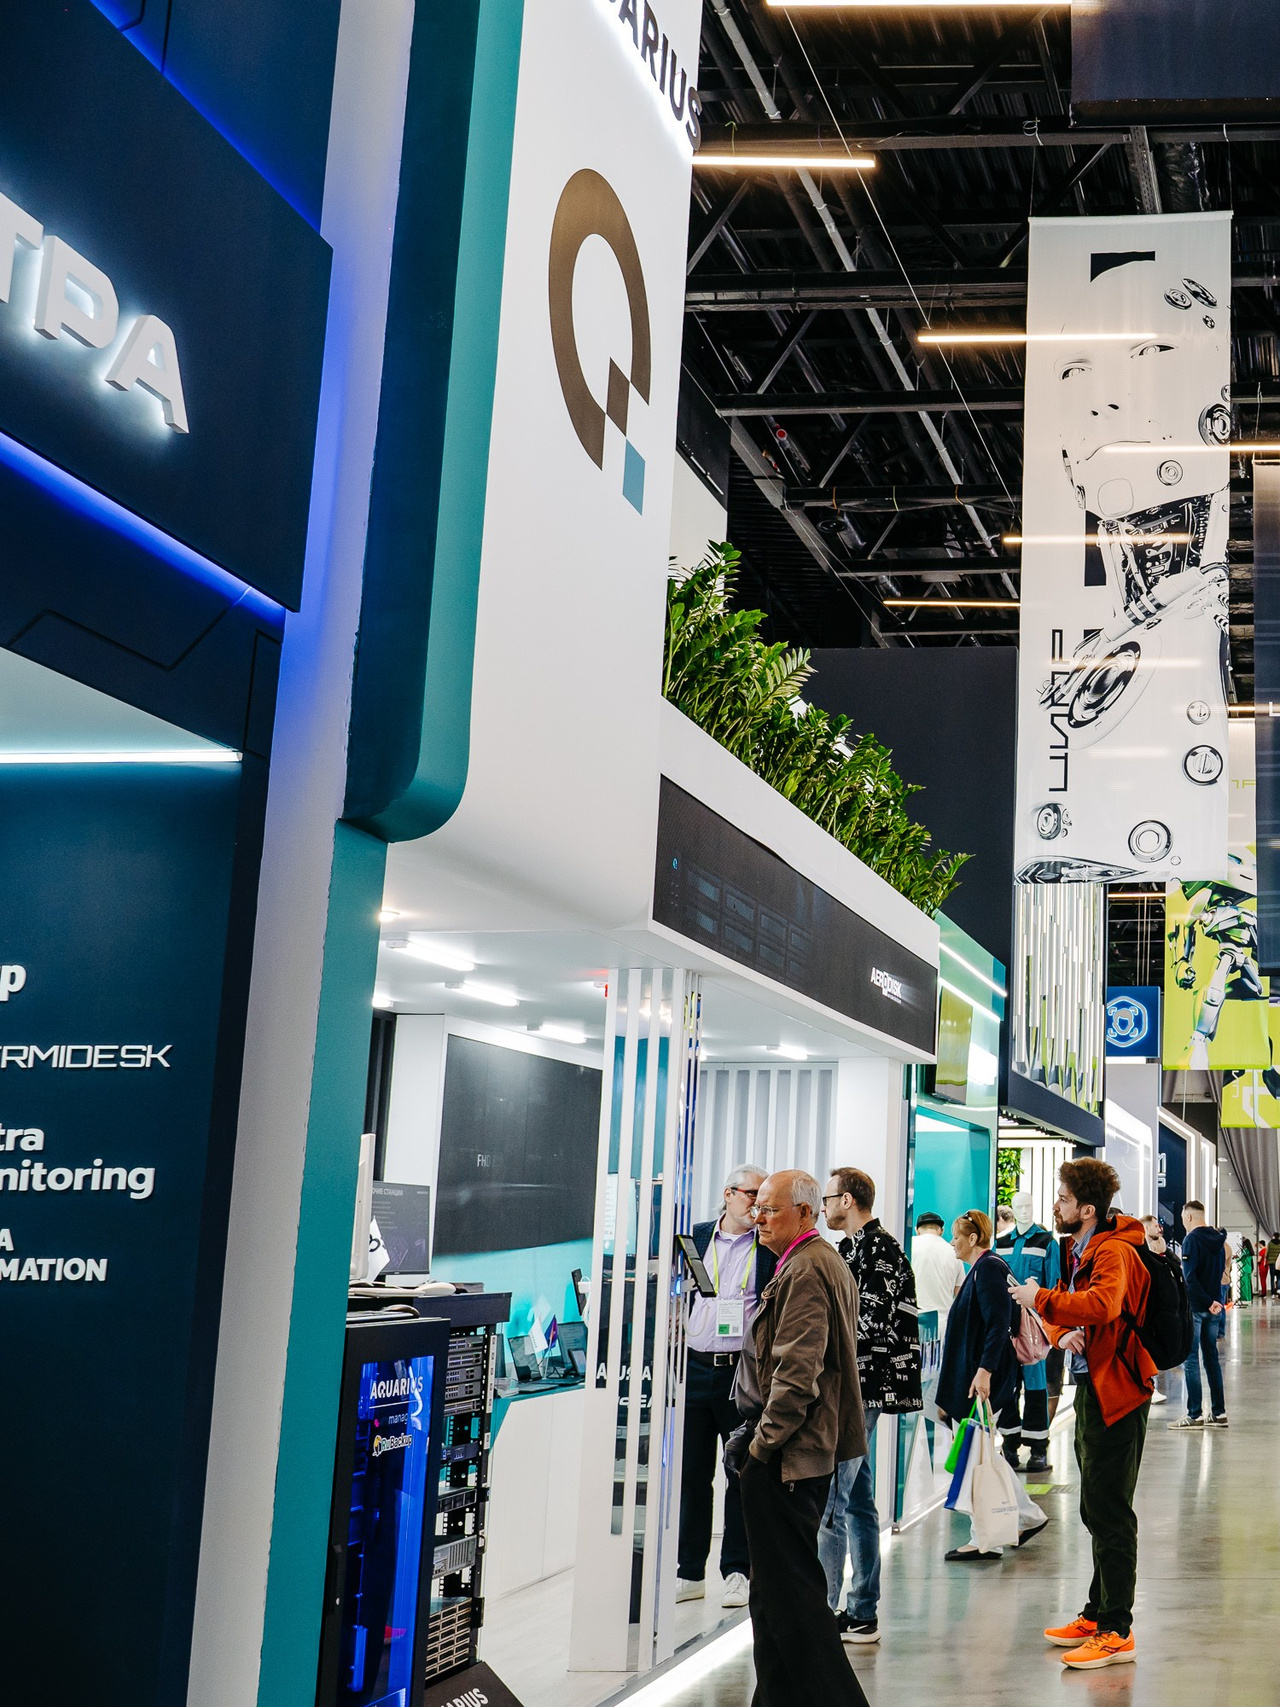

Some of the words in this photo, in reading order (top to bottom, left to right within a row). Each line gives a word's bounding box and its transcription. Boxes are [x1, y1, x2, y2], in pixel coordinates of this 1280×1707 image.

[609, 0, 702, 151] ARIUS
[0, 1044, 172, 1068] RMIDESK
[370, 1376, 424, 1400] AQUARIUS
